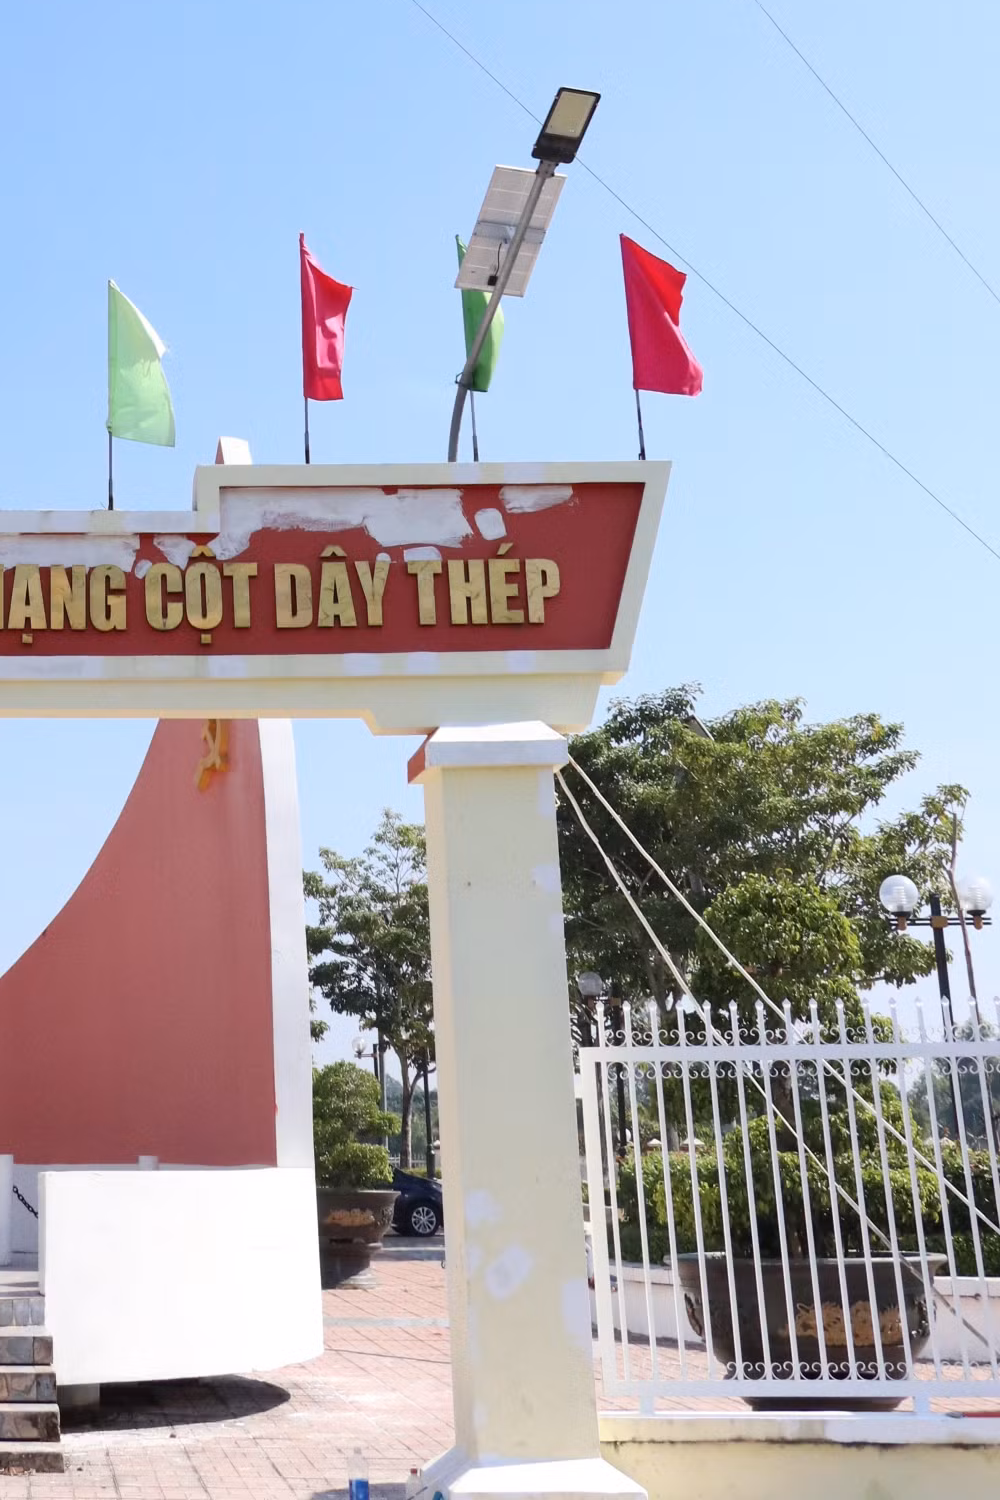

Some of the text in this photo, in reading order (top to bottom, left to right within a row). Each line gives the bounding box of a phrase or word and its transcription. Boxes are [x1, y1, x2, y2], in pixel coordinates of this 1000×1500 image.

[144, 545, 258, 644] CỘT
[273, 545, 391, 629] DÂY
[406, 542, 562, 626] THÉP
